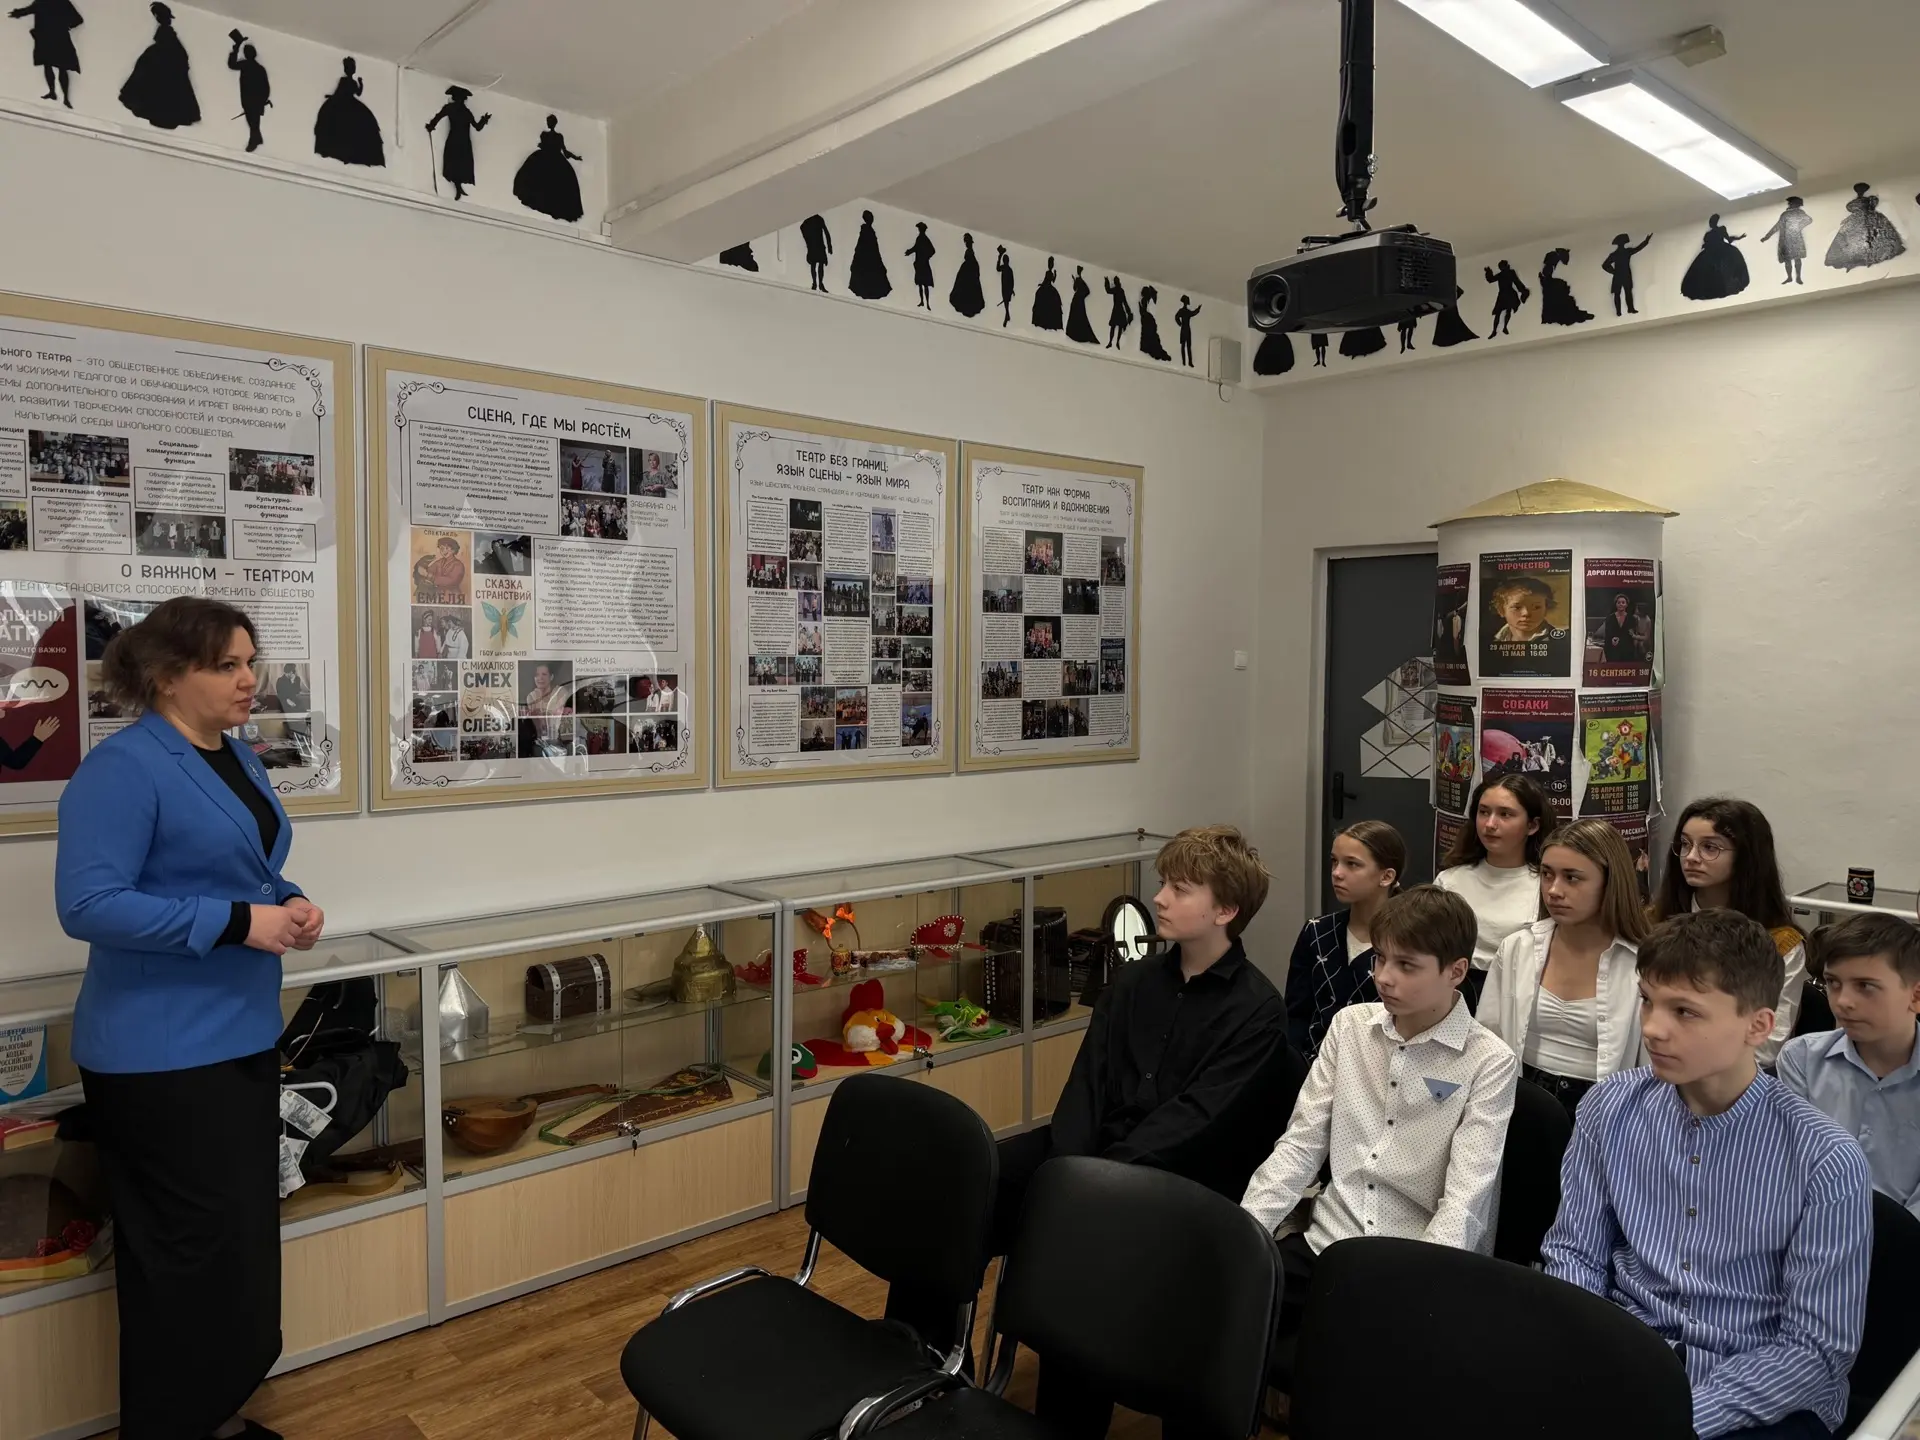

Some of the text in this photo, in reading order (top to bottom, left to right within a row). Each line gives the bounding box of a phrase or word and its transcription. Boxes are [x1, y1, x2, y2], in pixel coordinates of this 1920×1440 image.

[36, 351, 72, 363] ТЕАТРА
[86, 357, 105, 367] ЭТО
[108, 360, 180, 377] ОБЩЕСТВЕННОЕ
[183, 369, 246, 384] ОБЪЕДИНЕНИЕ,
[248, 377, 297, 390] СОЗДАННОЕ
[16, 364, 70, 378] УСИЛИЯМИ
[73, 370, 127, 385] ПЕДАГОГОВ
[130, 377, 137, 385] И
[212, 388, 250, 399] КОТОРОЕ
[253, 392, 295, 404] ЯВЛЯЕТСЯ
[26, 381, 118, 399] ДОПОЛНИТЕЛЬНОГО
[121, 391, 186, 405] ОБРАЗОВАНИЯ
[198, 399, 229, 411] ИГРАЕТ
[271, 408, 293, 418] РОЛЬ
[20, 395, 70, 408] РАЗВИТИИ
[73, 400, 133, 414] ТВОРЧЕСКИХ
[136, 407, 205, 422] СПОСОБНОСТЕЙ
[216, 415, 287, 430] ФОРМИРОВАНИИ
[14, 409, 77, 424] КУЛЬТУРНОЙ
[80, 416, 114, 427] СРЕДЫ
[116, 421, 171, 433] ШКОЛЬНОГО
[467, 405, 631, 439] СЦЕНА, ГДЕ МЫ РАСТЁМ
[796, 449, 889, 473] ТЕАТР БЕЗ ГРАНИЦ:
[776, 463, 805, 477] ЯЗЫК
[809, 467, 842, 482] СЦЕНЫ
[856, 473, 882, 487] ЯЗЫК
[885, 477, 910, 490] МИРА
[1021, 483, 1091, 500] ТЕАТР КАК ФОРМА
[1002, 495, 1110, 515] ВОСПИТАНИЯ И ВДОХНОВЕНИЯ
[423, 529, 459, 537] СПЕКТАКЛЬ
[121, 563, 132, 578] О
[141, 564, 217, 580] ВАЖНОМ
[243, 568, 314, 583] ТЕАТРОМ
[1497, 561, 1551, 571] ОТРОЧЕСТВО
[1586, 569, 1616, 577] ДОРОГАЯ
[55, 582, 131, 594] СТАНОВИТСЯ
[135, 583, 197, 596] СПОСОБОМ
[201, 585, 256, 597] ИЗМЕНИТЬ
[260, 587, 315, 599] ОБЩЕСТВО
[484, 578, 523, 590] СКАЗКА
[416, 591, 466, 605] ЕМЕЛЯ
[475, 589, 532, 601] СТРАНСТВИЙ
[1552, 630, 1564, 638] 12+
[38, 646, 67, 654] ВАЖНО
[1499, 643, 1526, 651] АПРЕЛЯ
[470, 661, 515, 671] МИХАЛКОВ
[1589, 669, 1598, 677] 16
[1600, 668, 1636, 677] СЕНТЯБРЯ
[463, 672, 512, 689] СМЕХ
[1502, 699, 1549, 710] СОБАКИ
[462, 714, 515, 733] СЛЁЗЫ
[1600, 785, 1624, 793] АПРЕЛЯ
[1600, 792, 1624, 800] АПРЕЛЯ
